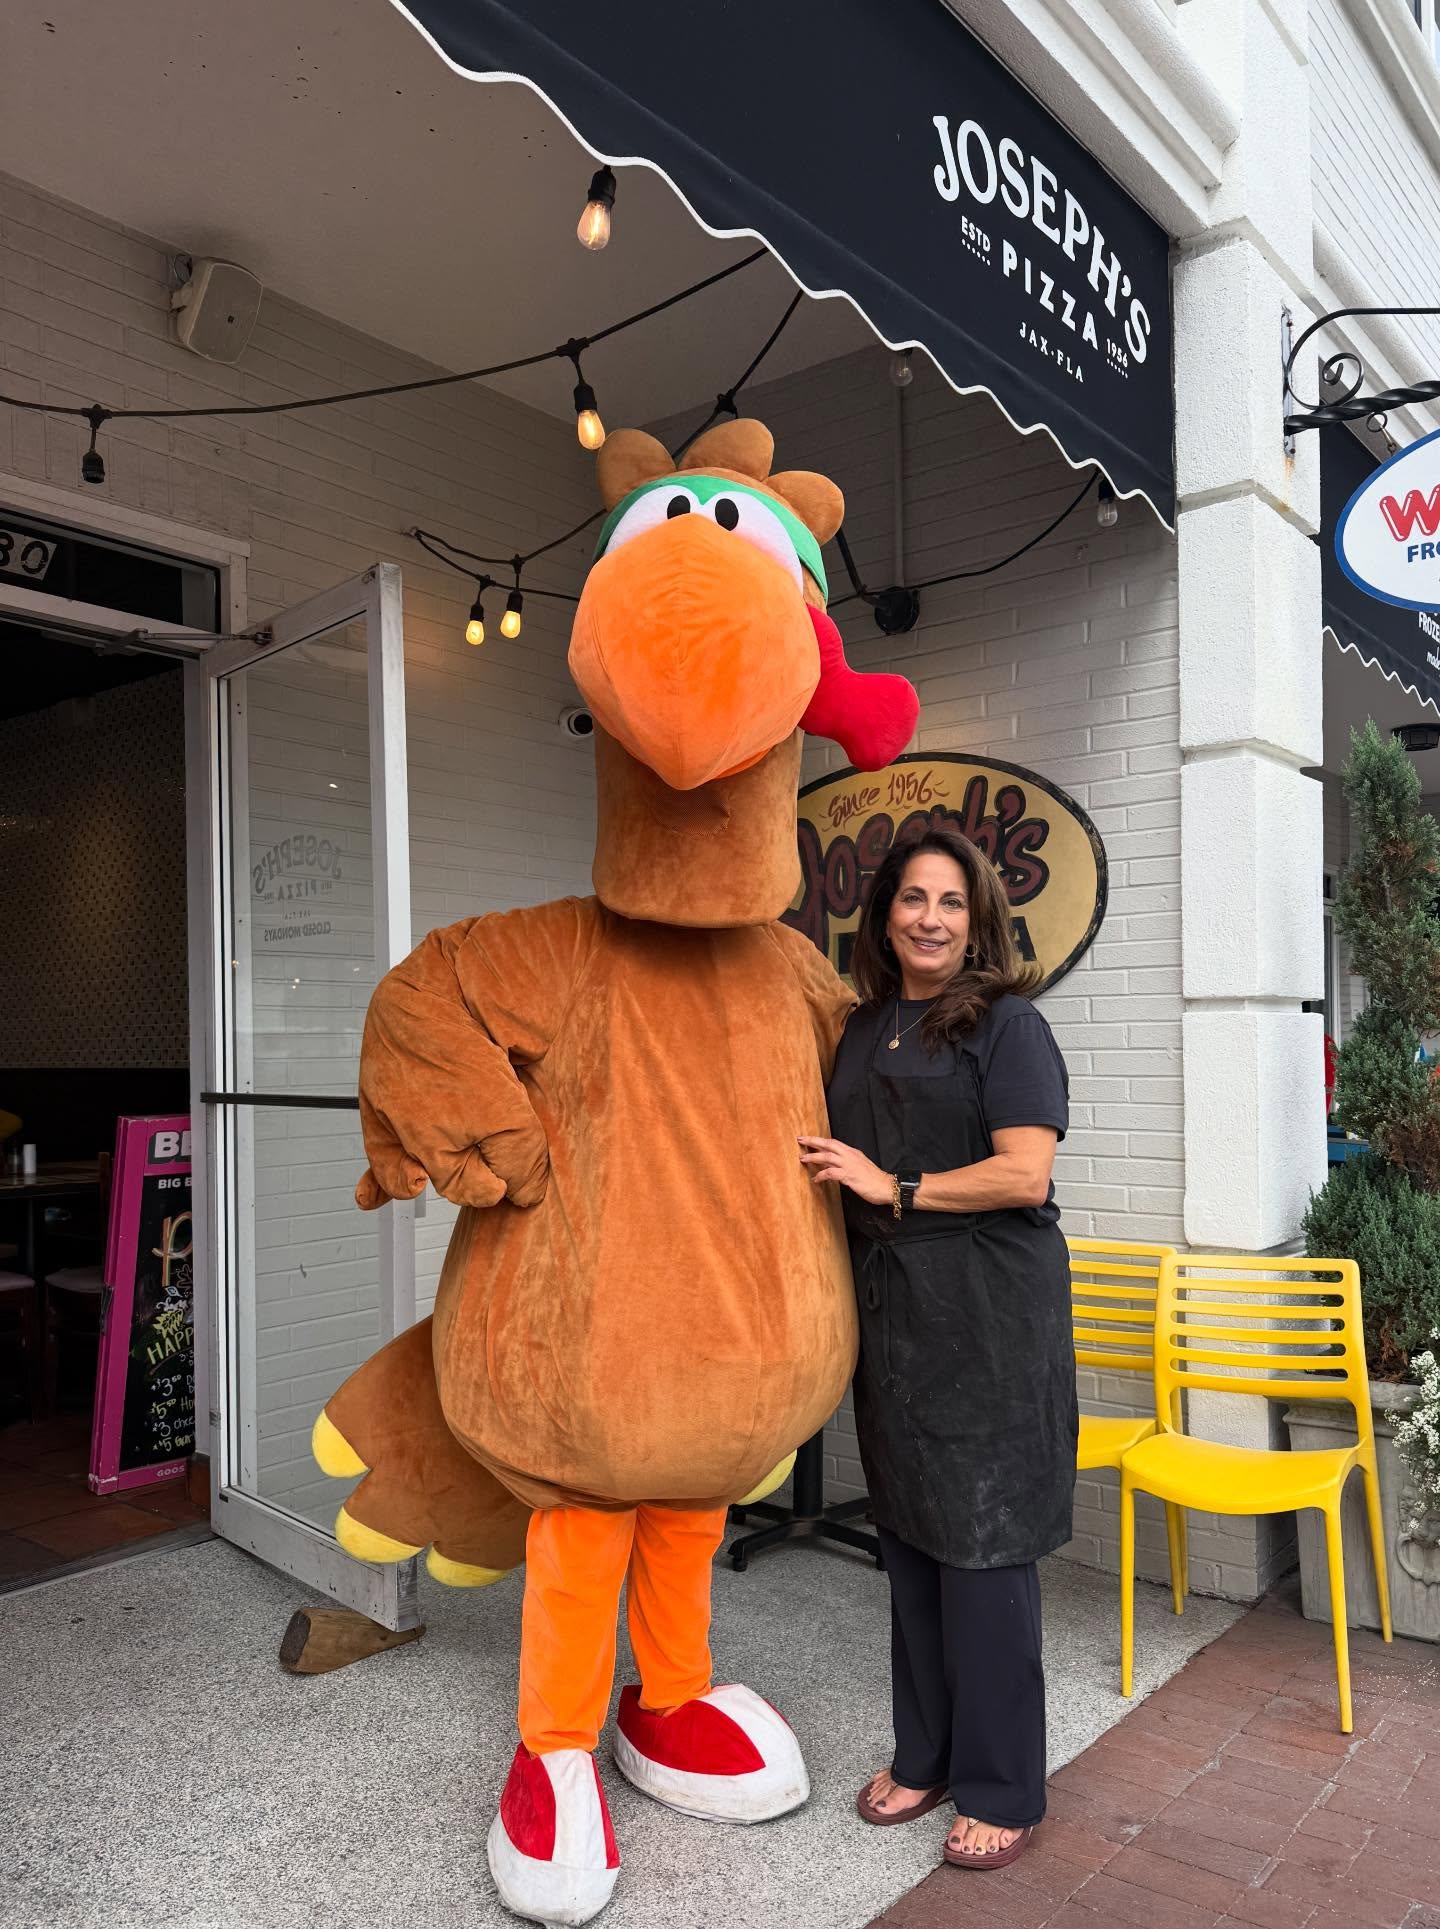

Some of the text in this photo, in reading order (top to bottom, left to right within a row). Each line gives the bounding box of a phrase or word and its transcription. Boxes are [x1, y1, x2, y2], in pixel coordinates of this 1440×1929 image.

[932, 115, 1151, 364] JOSEPH'S
[961, 215, 991, 252] ESTD
[1002, 238, 1099, 351] PIZZA
[1106, 338, 1128, 367] 1956
[884, 770, 934, 807] 1956
[158, 1178, 181, 1189] BIG
